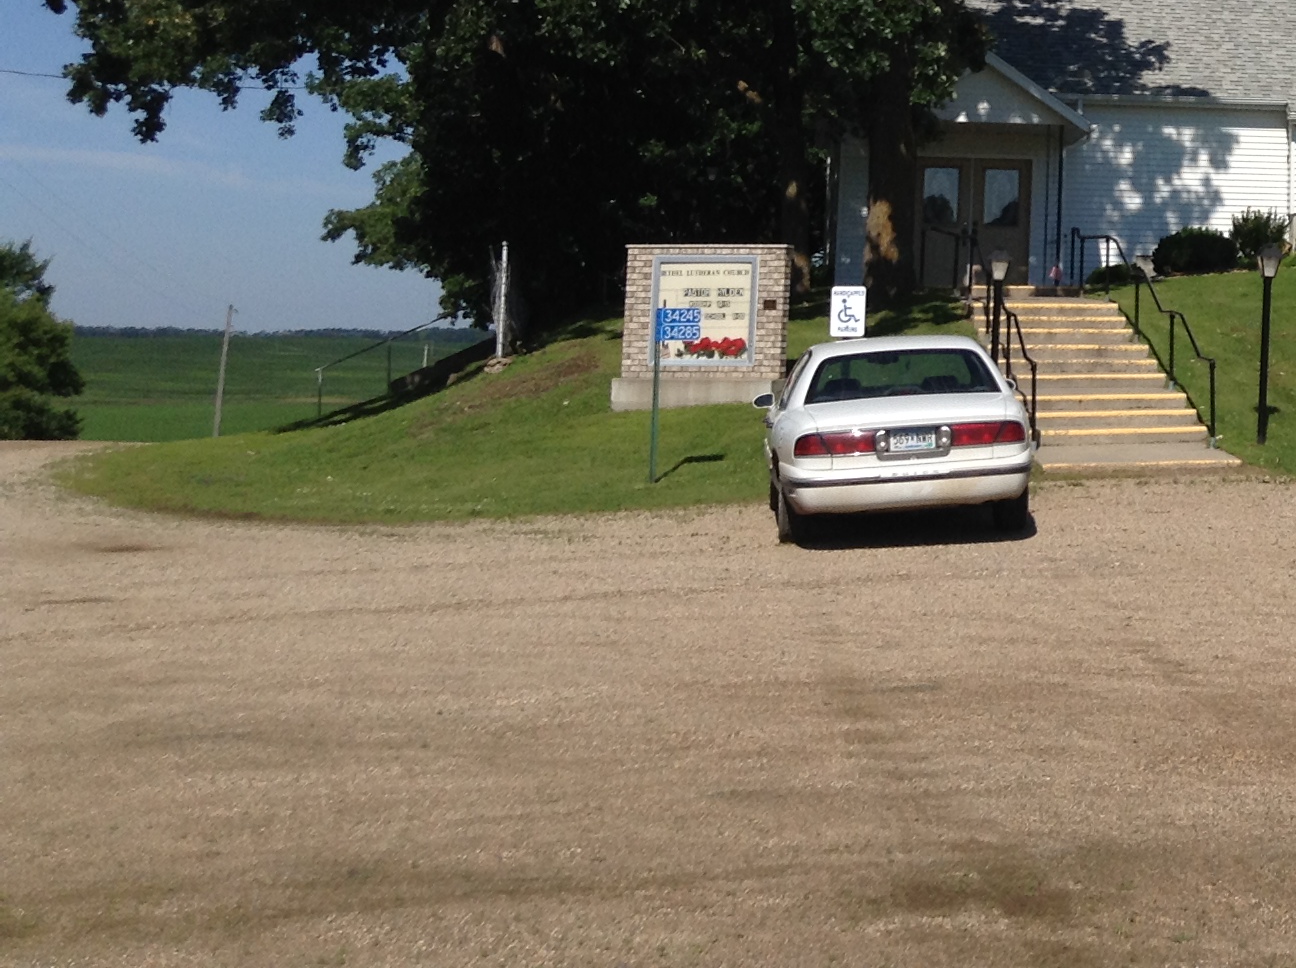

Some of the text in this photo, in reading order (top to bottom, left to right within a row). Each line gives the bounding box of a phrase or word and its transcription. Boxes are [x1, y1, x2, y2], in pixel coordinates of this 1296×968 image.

[686, 269, 720, 277] LUTHERAN
[723, 268, 750, 276] CHURCH
[683, 288, 710, 297] PASTOR
[664, 309, 700, 322] 34245
[664, 326, 700, 339] 34285
